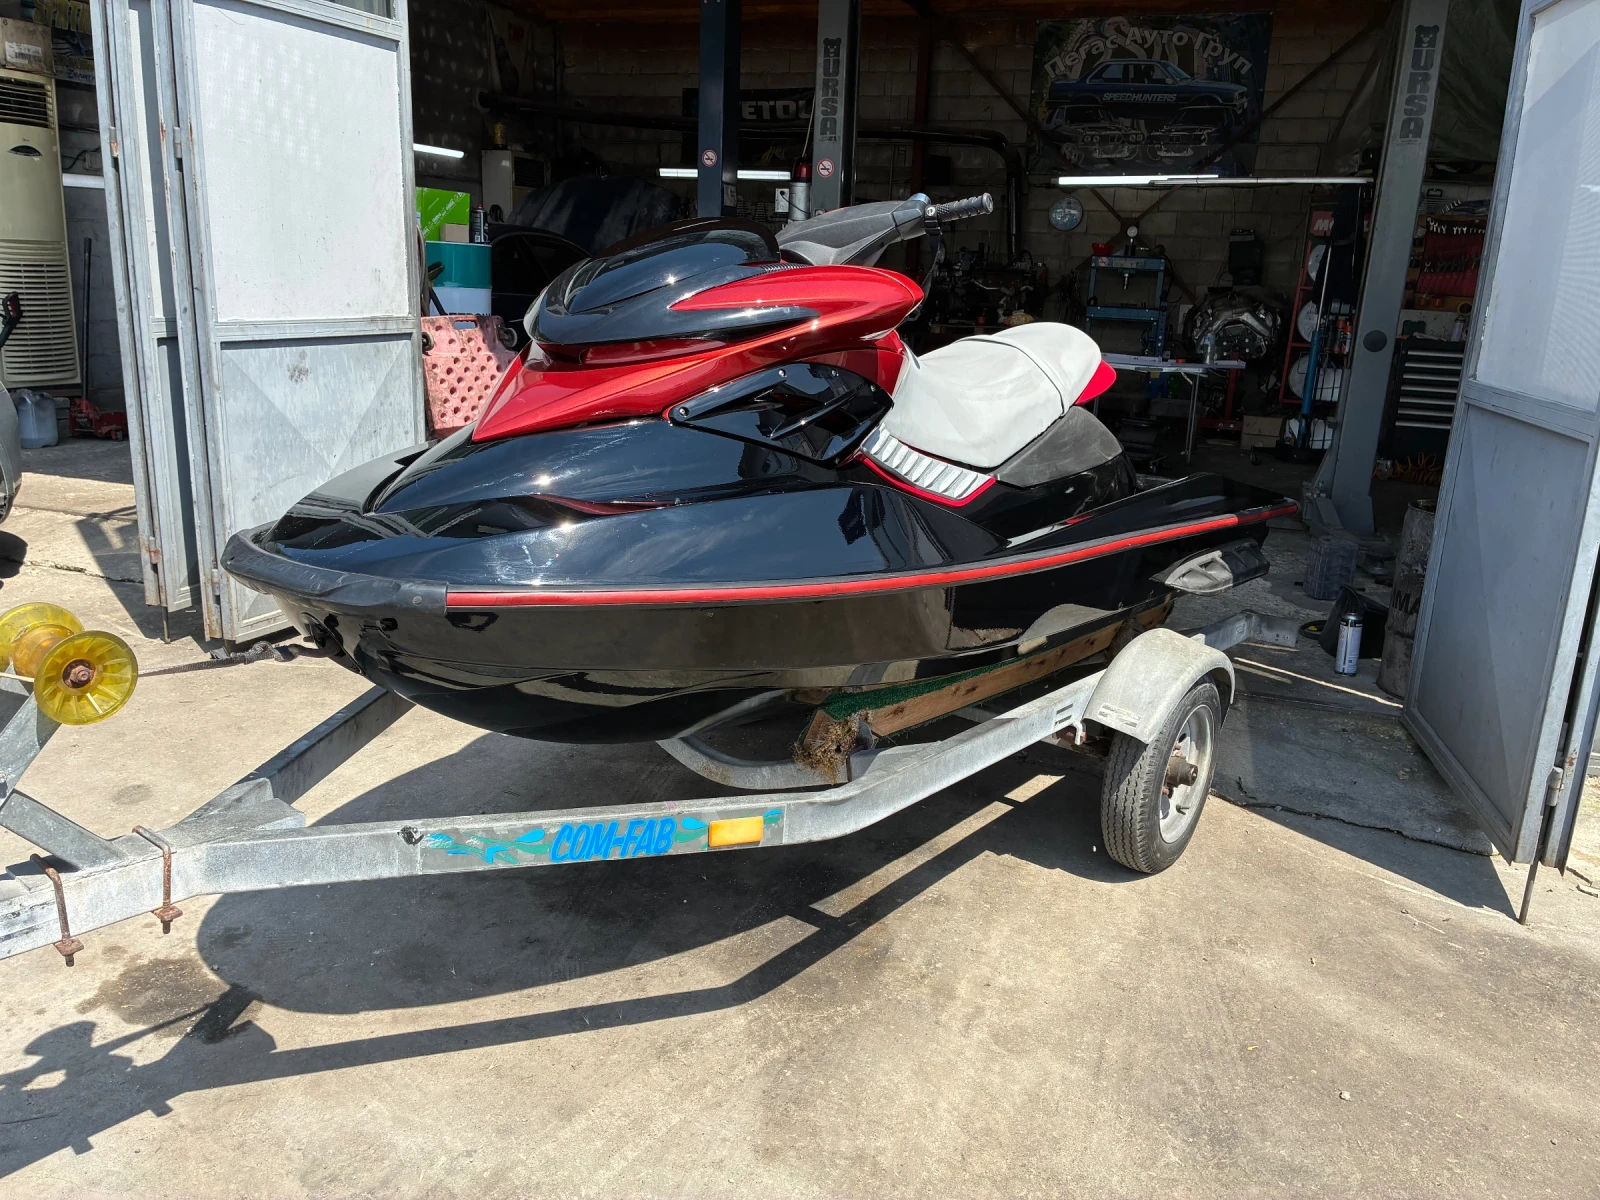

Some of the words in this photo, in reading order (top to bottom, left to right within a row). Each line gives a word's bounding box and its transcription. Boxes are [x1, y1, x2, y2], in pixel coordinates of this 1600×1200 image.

[1043, 34, 1119, 78] Пегас
[1126, 26, 1190, 47] Ауто
[1194, 32, 1252, 75] Груп
[820, 58, 840, 136] URSA
[1102, 92, 1177, 102] SPEEDHUNTERS
[1399, 48, 1435, 139] URSA
[550, 817, 677, 862] COM-FAB
